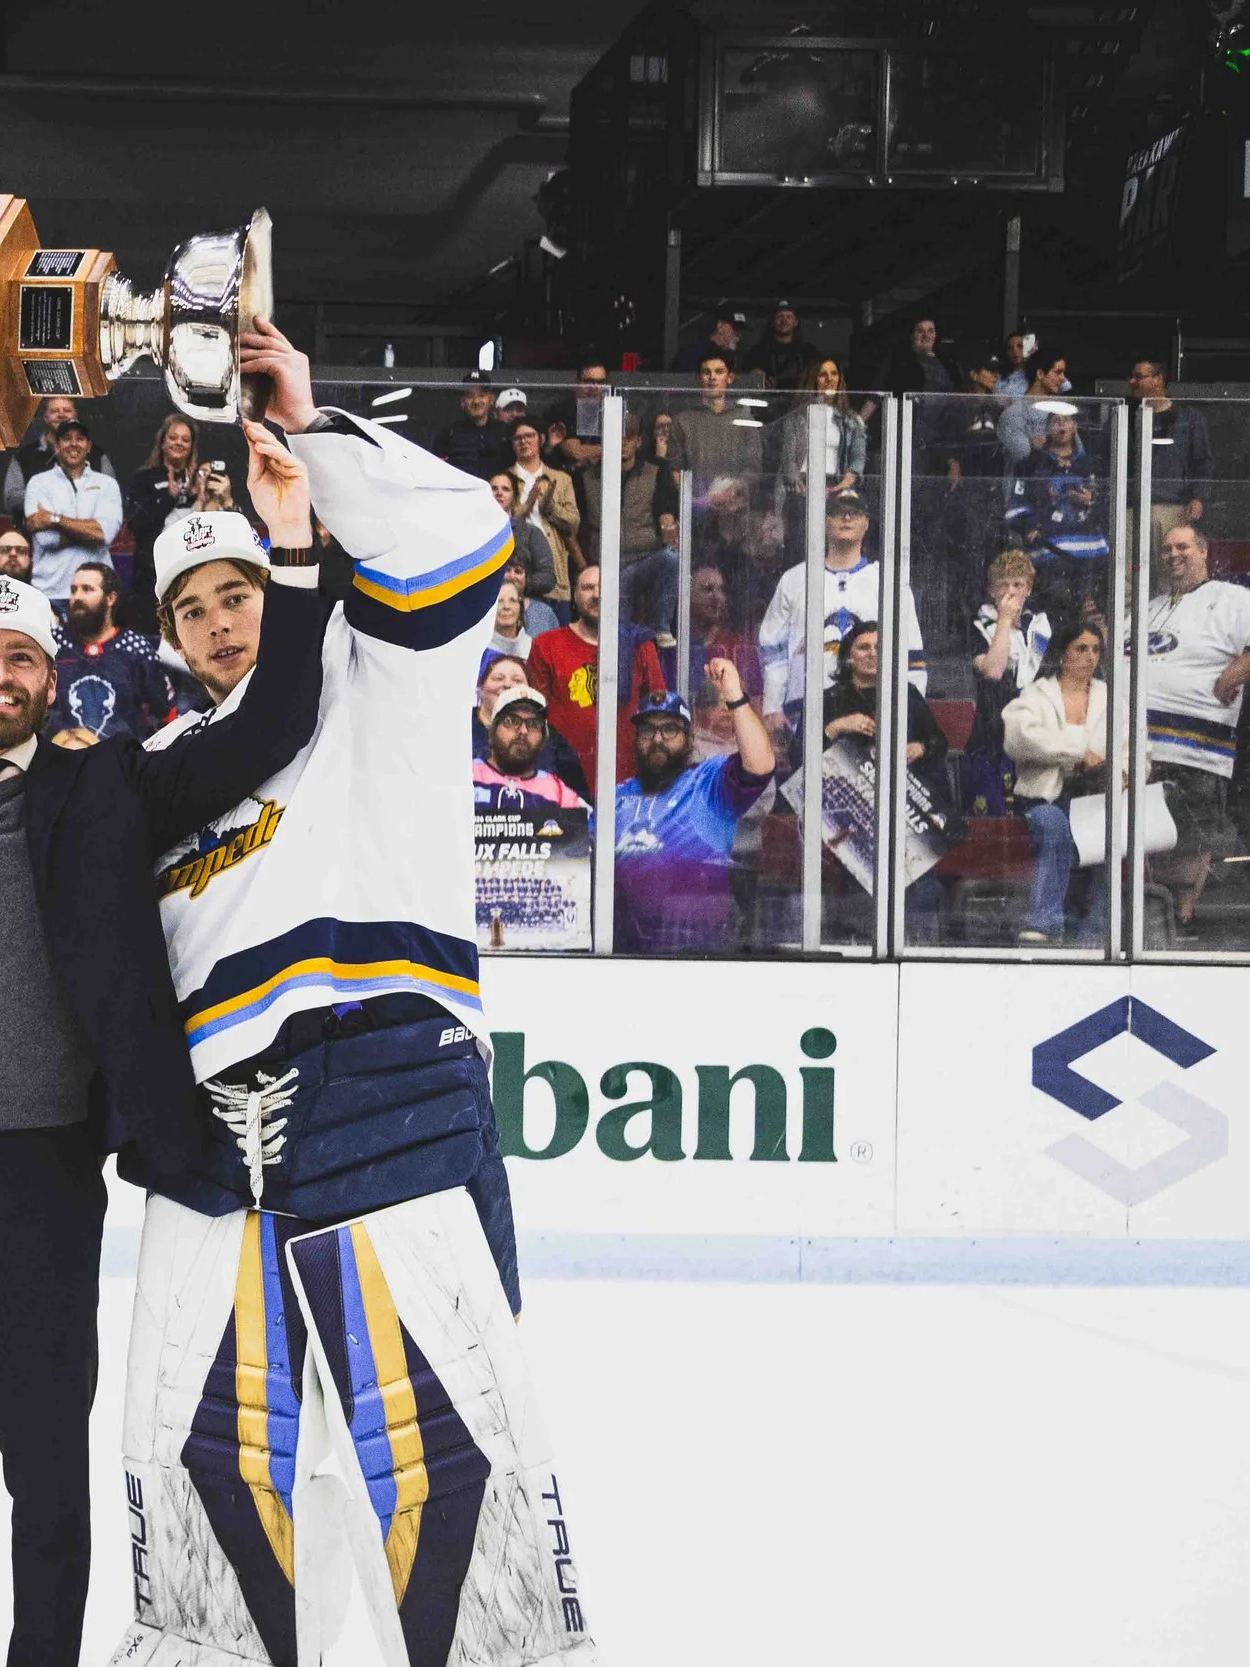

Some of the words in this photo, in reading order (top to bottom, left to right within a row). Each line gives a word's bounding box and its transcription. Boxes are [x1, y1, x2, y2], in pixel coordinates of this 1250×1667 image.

[498, 842, 552, 860] FALLS
[125, 1469, 153, 1617] TRUE
[541, 1473, 584, 1632] TRUE
